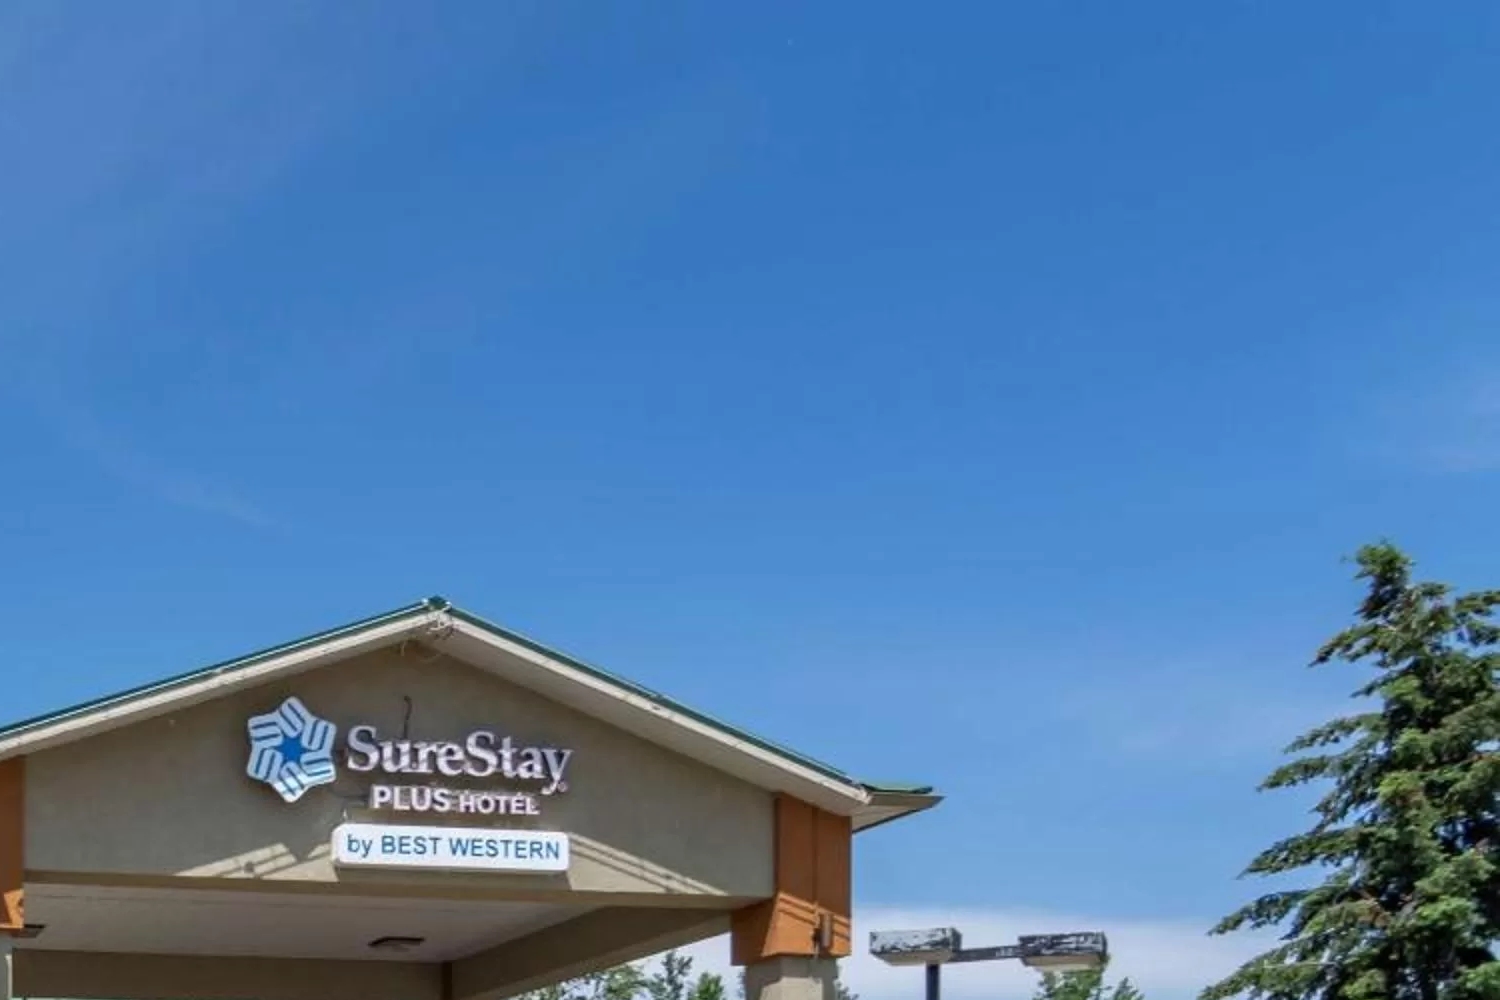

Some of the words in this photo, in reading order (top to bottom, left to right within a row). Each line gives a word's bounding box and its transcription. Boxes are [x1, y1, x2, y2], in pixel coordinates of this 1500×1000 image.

[347, 725, 573, 795] SureStay
[371, 785, 451, 812] PLUS
[458, 792, 540, 816] HOTEL
[348, 834, 373, 858] by
[381, 836, 442, 856] BEST
[450, 838, 560, 860] WESTERN
